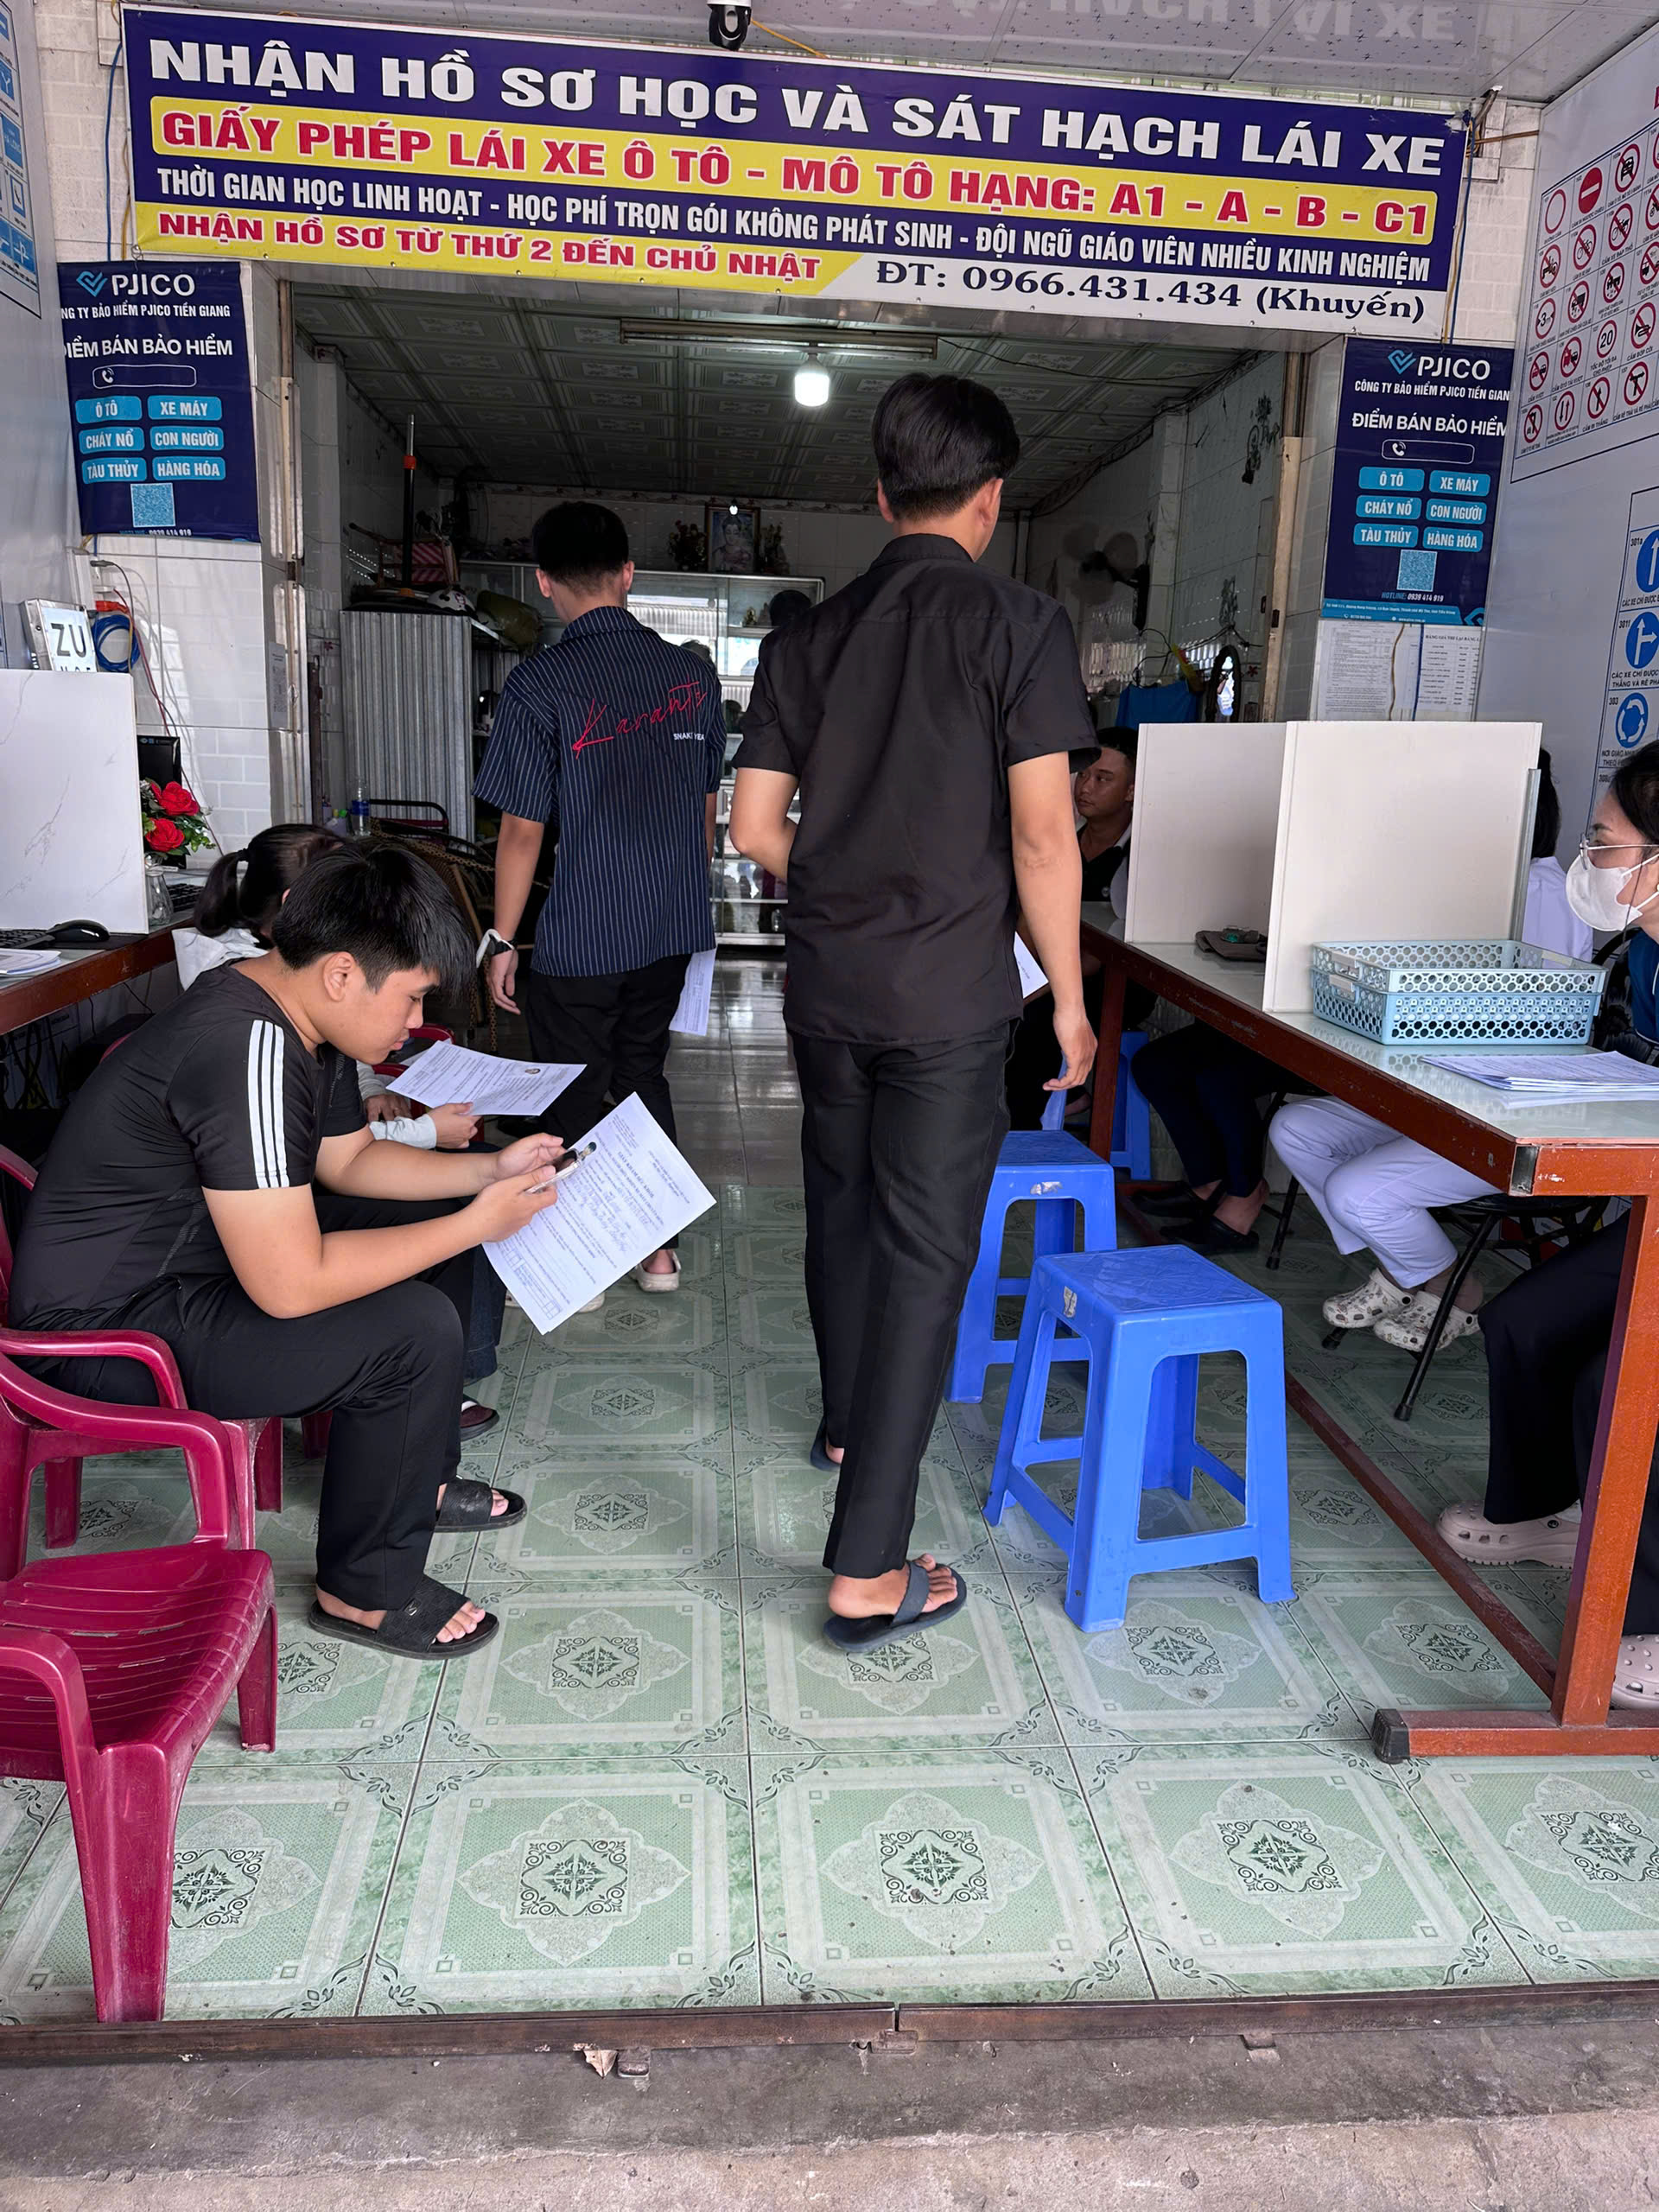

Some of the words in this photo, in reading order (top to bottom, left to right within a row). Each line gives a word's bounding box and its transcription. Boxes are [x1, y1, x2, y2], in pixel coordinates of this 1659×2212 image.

[149, 39, 355, 98] NHẬN
[382, 48, 474, 102] HỒ
[501, 67, 596, 111] SƠ
[620, 75, 759, 128] HỌC
[781, 84, 869, 133] VÀ
[892, 94, 1021, 144] SÁT
[1041, 109, 1221, 161] HẠCH
[1242, 121, 1342, 168] LÁI
[1362, 132, 1446, 176] XE
[161, 104, 282, 153] GIẤY
[298, 121, 431, 163] PHÉP
[448, 129, 526, 172] LÁI
[542, 141, 606, 177] XE
[624, 138, 655, 180] Ô
[671, 145, 731, 185] TÔ
[747, 168, 765, 179] -
[782, 155, 860, 195] MÔ
[875, 161, 933, 200] TÔ
[950, 170, 1096, 213] HẠNG:
[1109, 183, 1165, 218] A1
[1185, 201, 1204, 211] -
[1217, 191, 1249, 224] A
[1264, 207, 1282, 216] -
[1296, 196, 1327, 228] B
[1342, 212, 1359, 221] -
[1375, 201, 1427, 235] C1
[157, 163, 216, 198] THỜI
[223, 172, 285, 203] GIAN
[293, 178, 345, 211] HỌC
[353, 181, 410, 212] LINH
[417, 187, 483, 222] HOẠT
[507, 194, 557, 226] HỌC
[566, 192, 607, 227] PHÍ
[614, 201, 678, 232] TRỌN
[687, 201, 728, 234] GÓI
[735, 207, 819, 241] KHÔNG
[826, 213, 888, 245] PHÁT
[894, 220, 952, 250] SINH
[976, 222, 1015, 258] ĐỘI
[1023, 226, 1071, 257] NGŨ
[1079, 231, 1135, 263] GIÁO
[1142, 236, 1194, 267] VIÊN
[1201, 238, 1271, 272] NHIỀU
[1278, 247, 1333, 276] KINH
[1339, 251, 1430, 285] NGHIỆM
[159, 213, 263, 244] NHẬN
[276, 216, 324, 245] HỒ
[336, 225, 385, 249] SƠ
[395, 227, 444, 253] TỪ
[450, 232, 522, 260] THỨ
[530, 239, 551, 263] 2
[563, 236, 634, 267] ĐẾN
[646, 244, 716, 272] CHỦ
[728, 251, 821, 283] NHẬT
[111, 273, 195, 296] PJICO
[876, 261, 946, 288] ĐT:
[963, 264, 1242, 307] 0966.431.434
[1256, 285, 1425, 324] (Khuyến)
[77, 307, 89, 319] TY
[92, 302, 111, 319] BẢO
[140, 304, 171, 316] PJICO
[199, 305, 231, 317] GIANG
[64, 335, 99, 359] IỂM
[102, 334, 139, 355] BÁN
[142, 334, 181, 355] BẢO
[186, 333, 233, 356] HIỂM
[1600, 330, 1613, 349] 20
[1417, 355, 1491, 380] PJICO
[1354, 380, 1380, 393] CÔNG
[1382, 382, 1393, 394] TY
[1394, 380, 1412, 395] BẢO
[1440, 385, 1465, 397] PJICO
[95, 401, 103, 418] Ô
[105, 400, 118, 416] TÔ
[161, 401, 176, 416] XE
[180, 398, 208, 416] MÁY
[1351, 407, 1394, 429] ĐIỂM
[1396, 413, 1433, 432] BÁN
[1435, 413, 1468, 434] BẢO
[86, 431, 111, 449] CHÁY
[155, 432, 179, 446] CON
[181, 429, 219, 448] NGƯỜI
[87, 461, 105, 480] TÀU
[156, 459, 190, 477] HÀNG
[193, 459, 220, 477] HÓA
[1390, 471, 1404, 487] TÔ
[1440, 476, 1453, 490] XE
[1456, 474, 1478, 492] MÁY
[1364, 499, 1394, 515] CHÁY
[1430, 504, 1450, 518] CON
[1453, 504, 1483, 522] NGƯỜI
[1361, 525, 1382, 543] TÀU
[1427, 530, 1454, 547] HÀNG
[1457, 531, 1478, 549] HÓA
